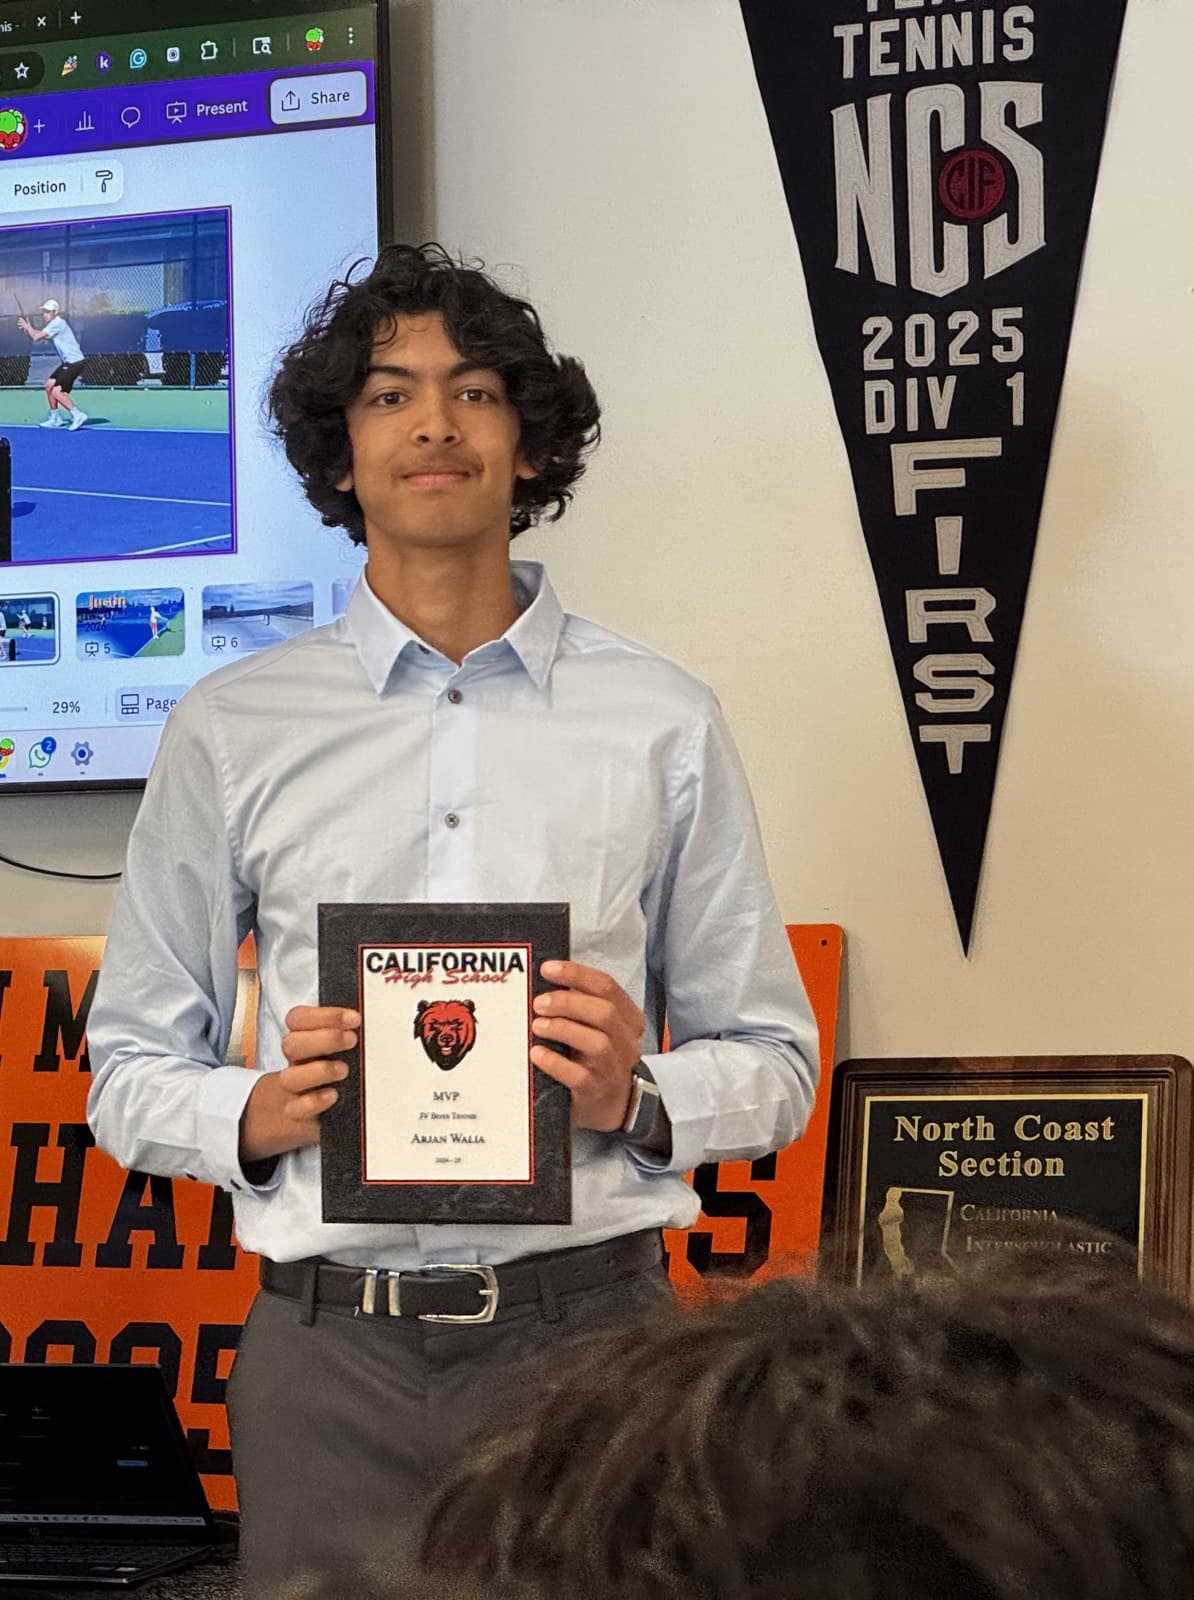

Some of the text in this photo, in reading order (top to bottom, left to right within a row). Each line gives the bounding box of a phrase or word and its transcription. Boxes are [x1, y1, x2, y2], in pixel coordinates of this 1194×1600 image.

[833, 5, 1034, 79] TENNIS
[196, 100, 248, 116] Present
[311, 90, 350, 105] Share
[14, 180, 67, 197] Position
[830, 81, 1046, 298] NCS
[862, 307, 1024, 371] 2025
[864, 372, 1025, 434] DIV 1
[890, 437, 1002, 775] FIRST
[103, 643, 111, 654] 5
[230, 636, 238, 648] 6
[52, 700, 81, 714] 29%
[366, 952, 525, 974] CALIFORNIA
[381, 967, 510, 989] High School
[433, 1091, 460, 1102] MVP
[893, 1114, 1115, 1142] North Coast
[938, 1150, 1065, 1177] Section
